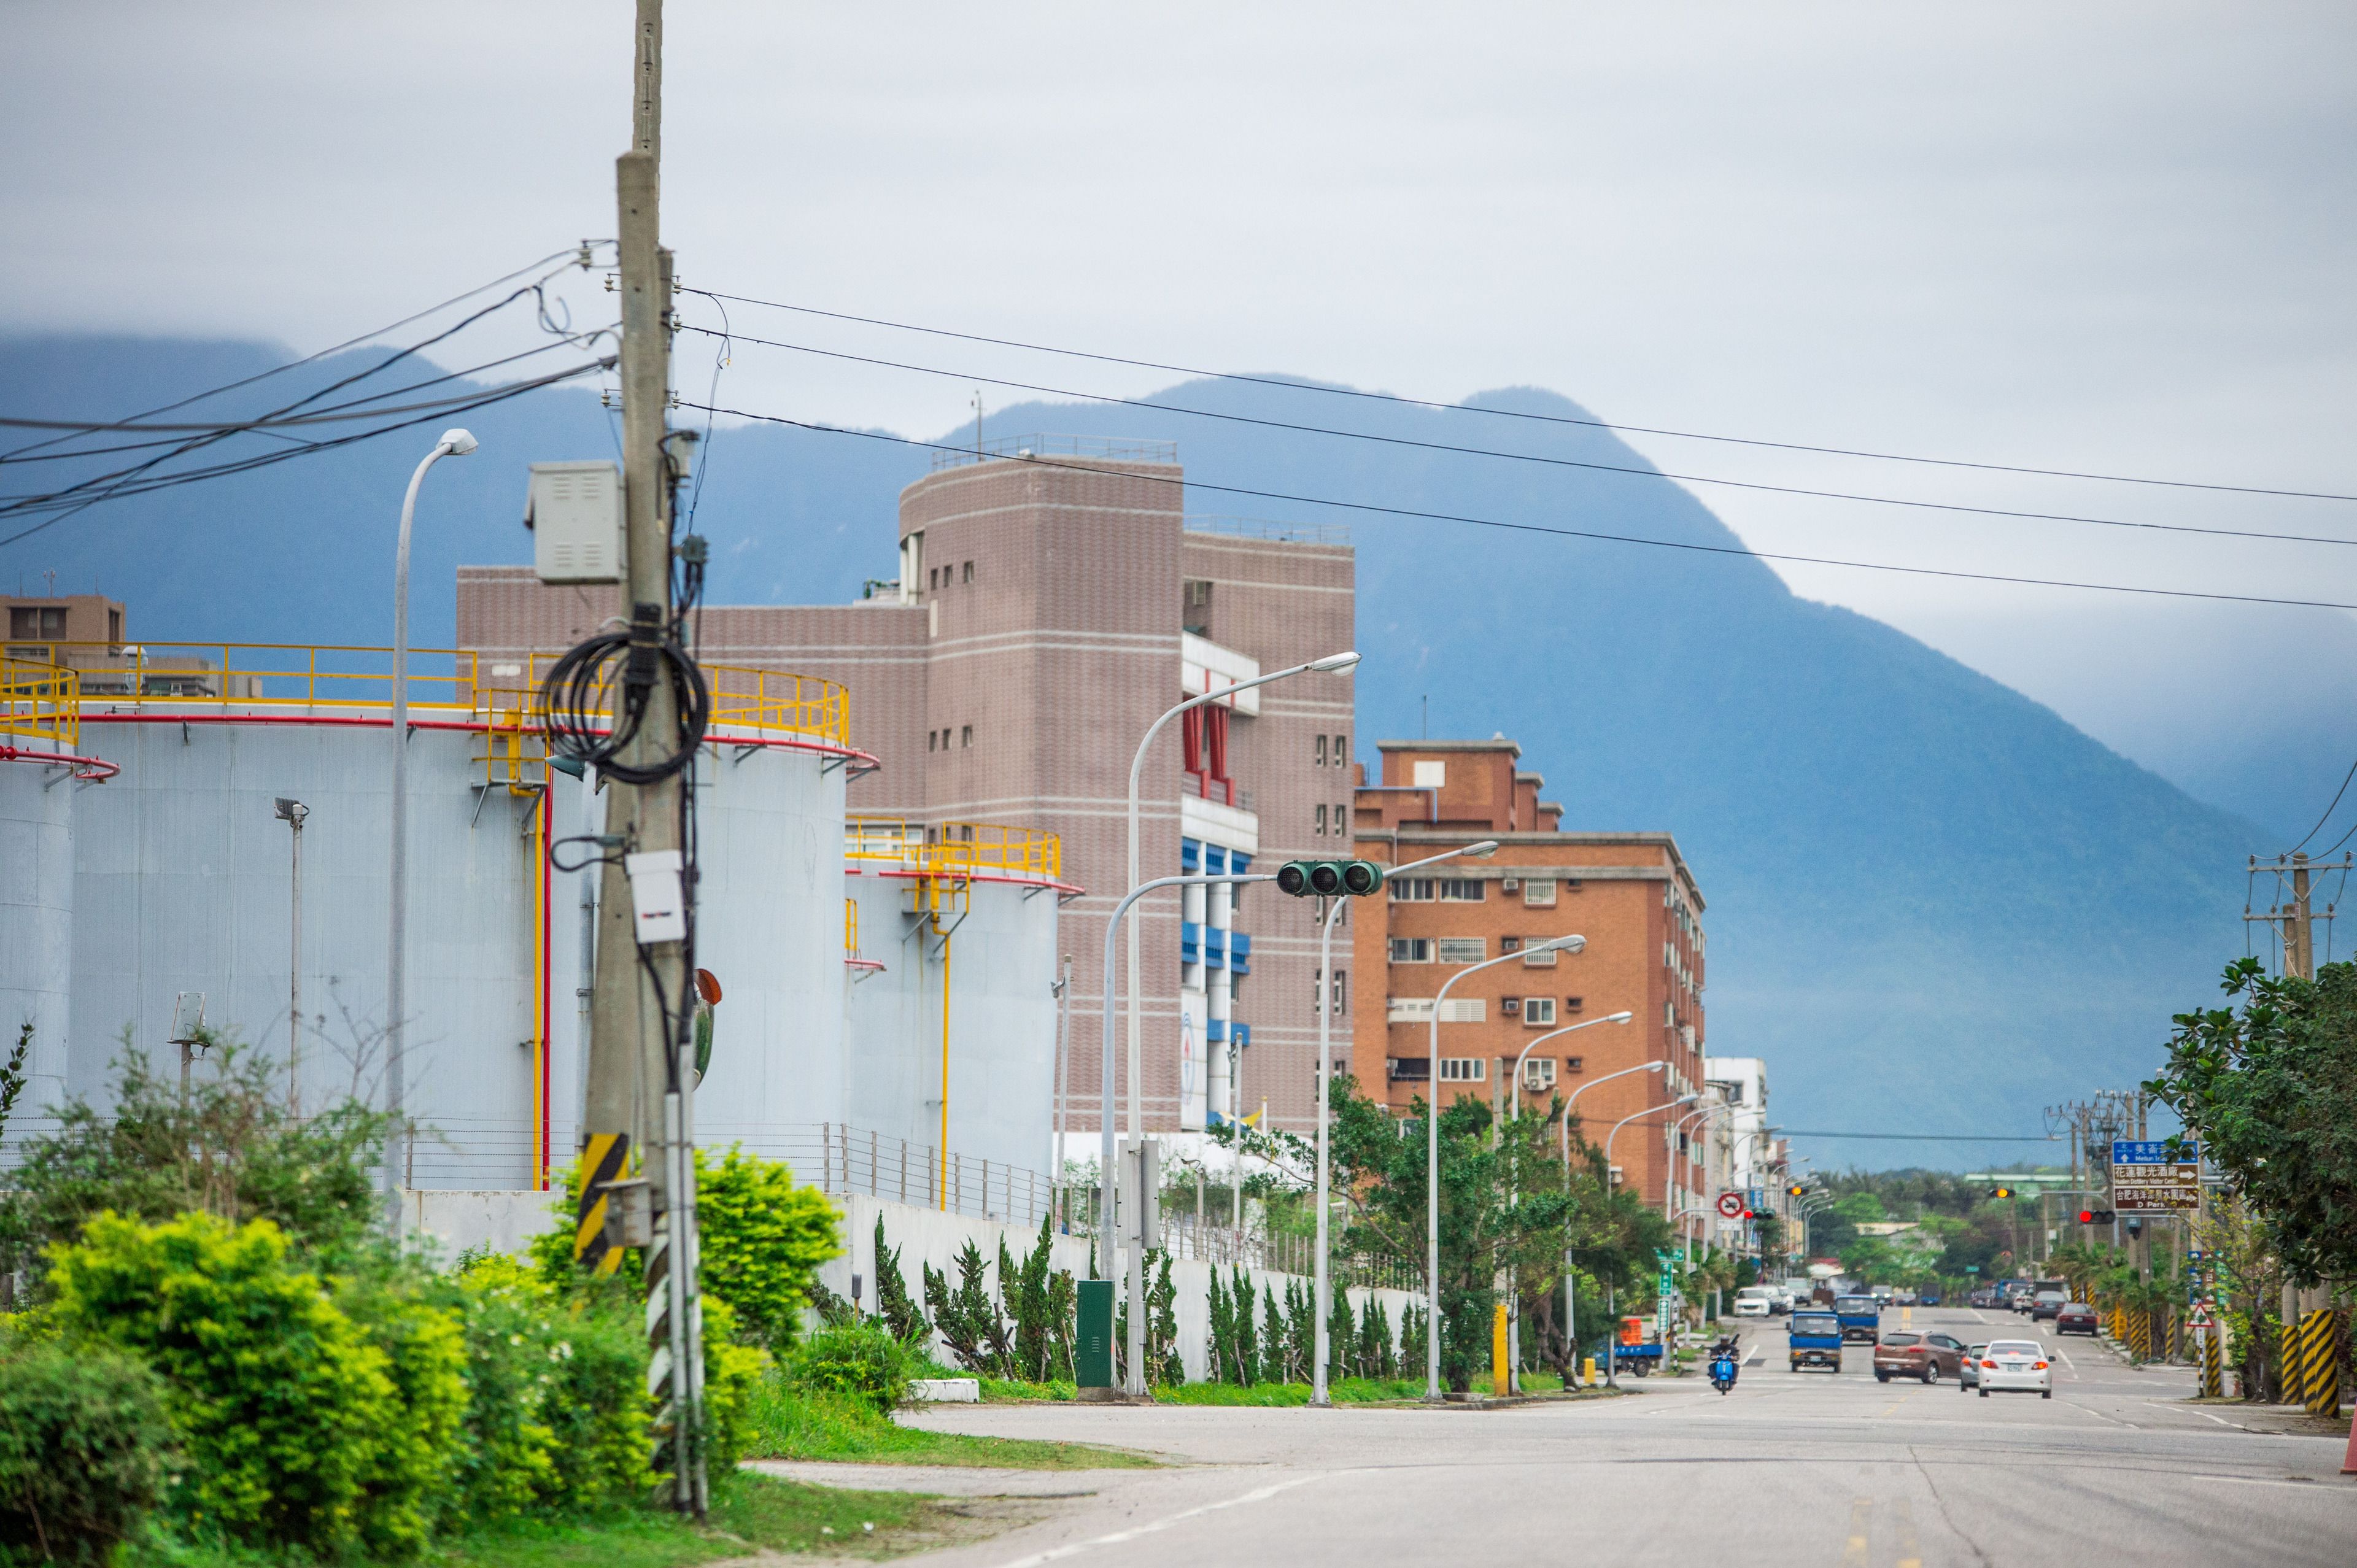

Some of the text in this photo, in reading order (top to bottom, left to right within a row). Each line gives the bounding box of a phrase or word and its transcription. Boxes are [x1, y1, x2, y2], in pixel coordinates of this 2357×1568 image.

[2115, 1166, 2178, 1177] 花蓮觀光酒廠
